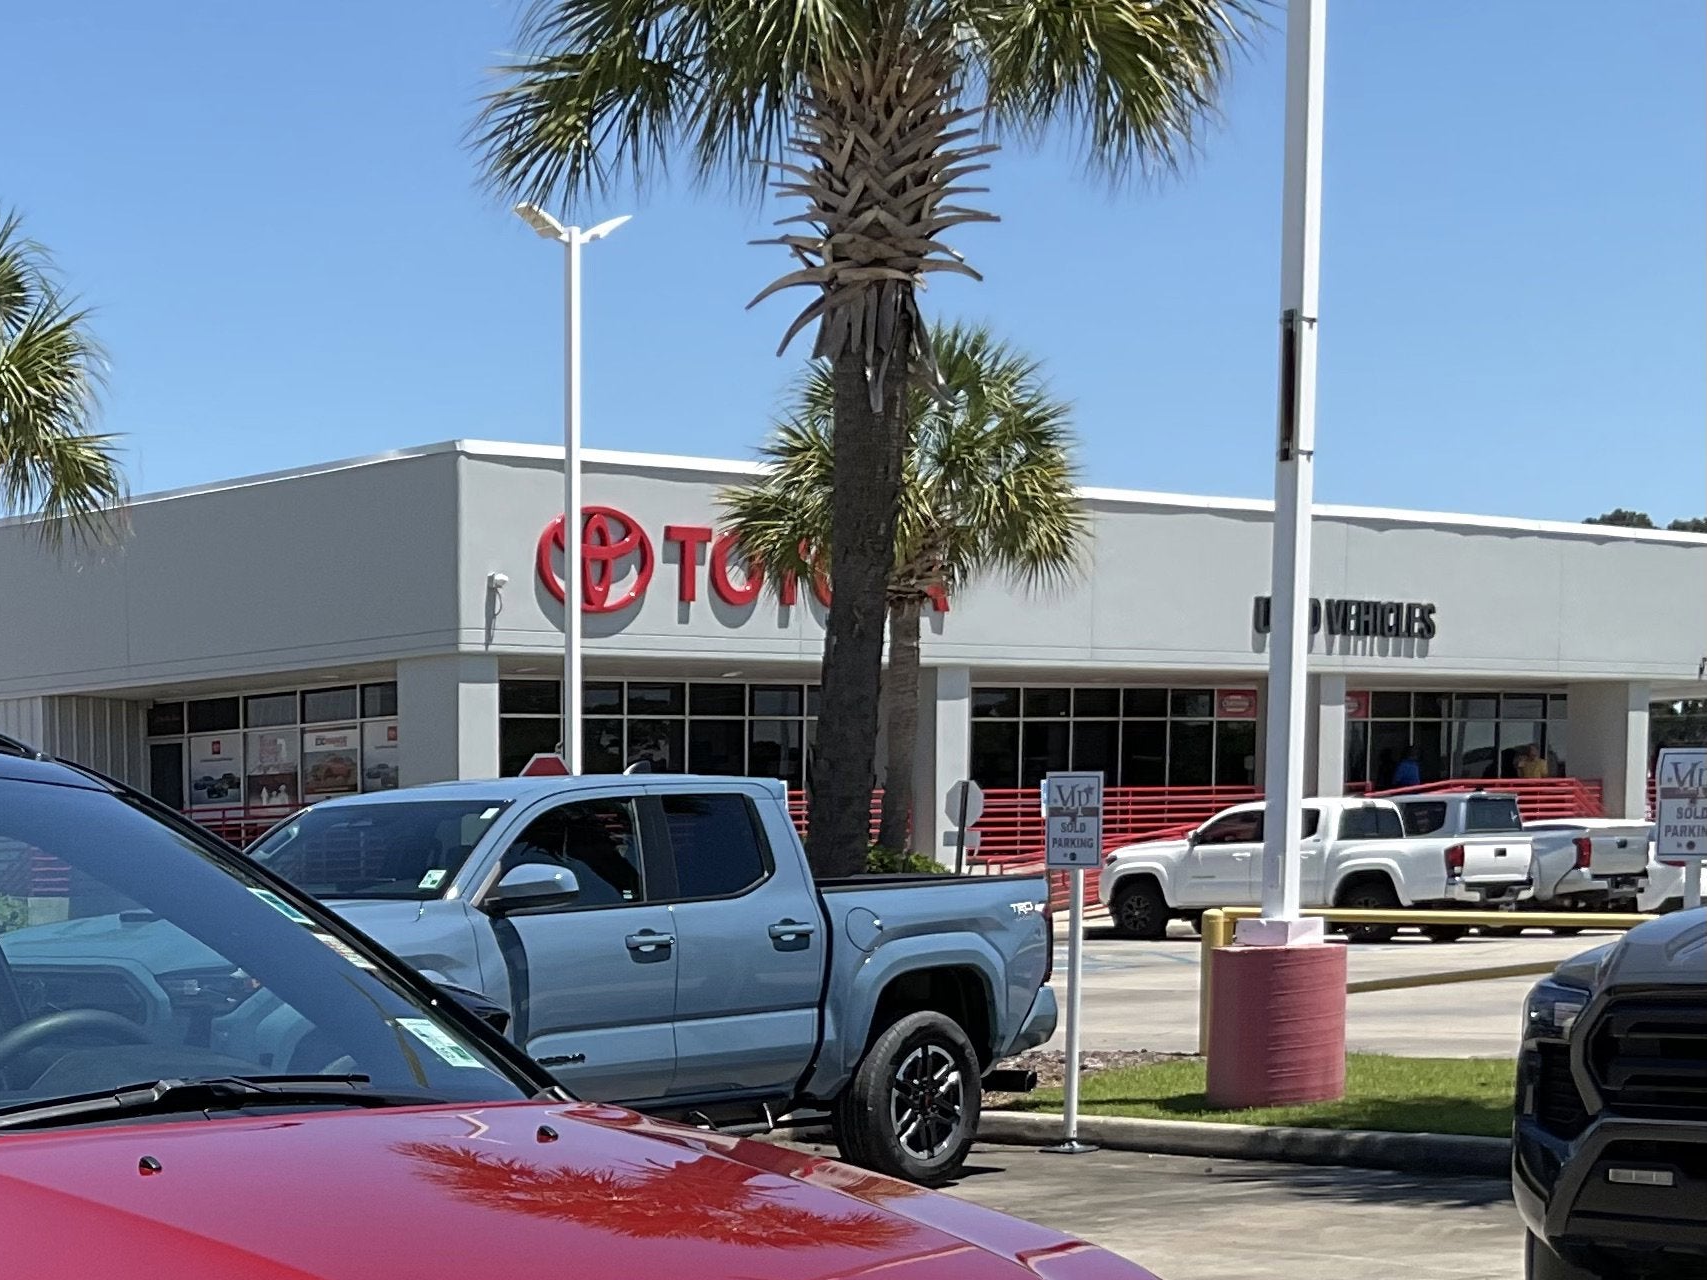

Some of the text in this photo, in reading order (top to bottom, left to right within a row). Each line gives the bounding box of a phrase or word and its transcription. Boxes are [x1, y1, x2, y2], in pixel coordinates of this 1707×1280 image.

[1254, 596, 1436, 639] UD VEHICLES
[1060, 822, 1086, 833] SOLD
[1052, 837, 1093, 848] PARKING
